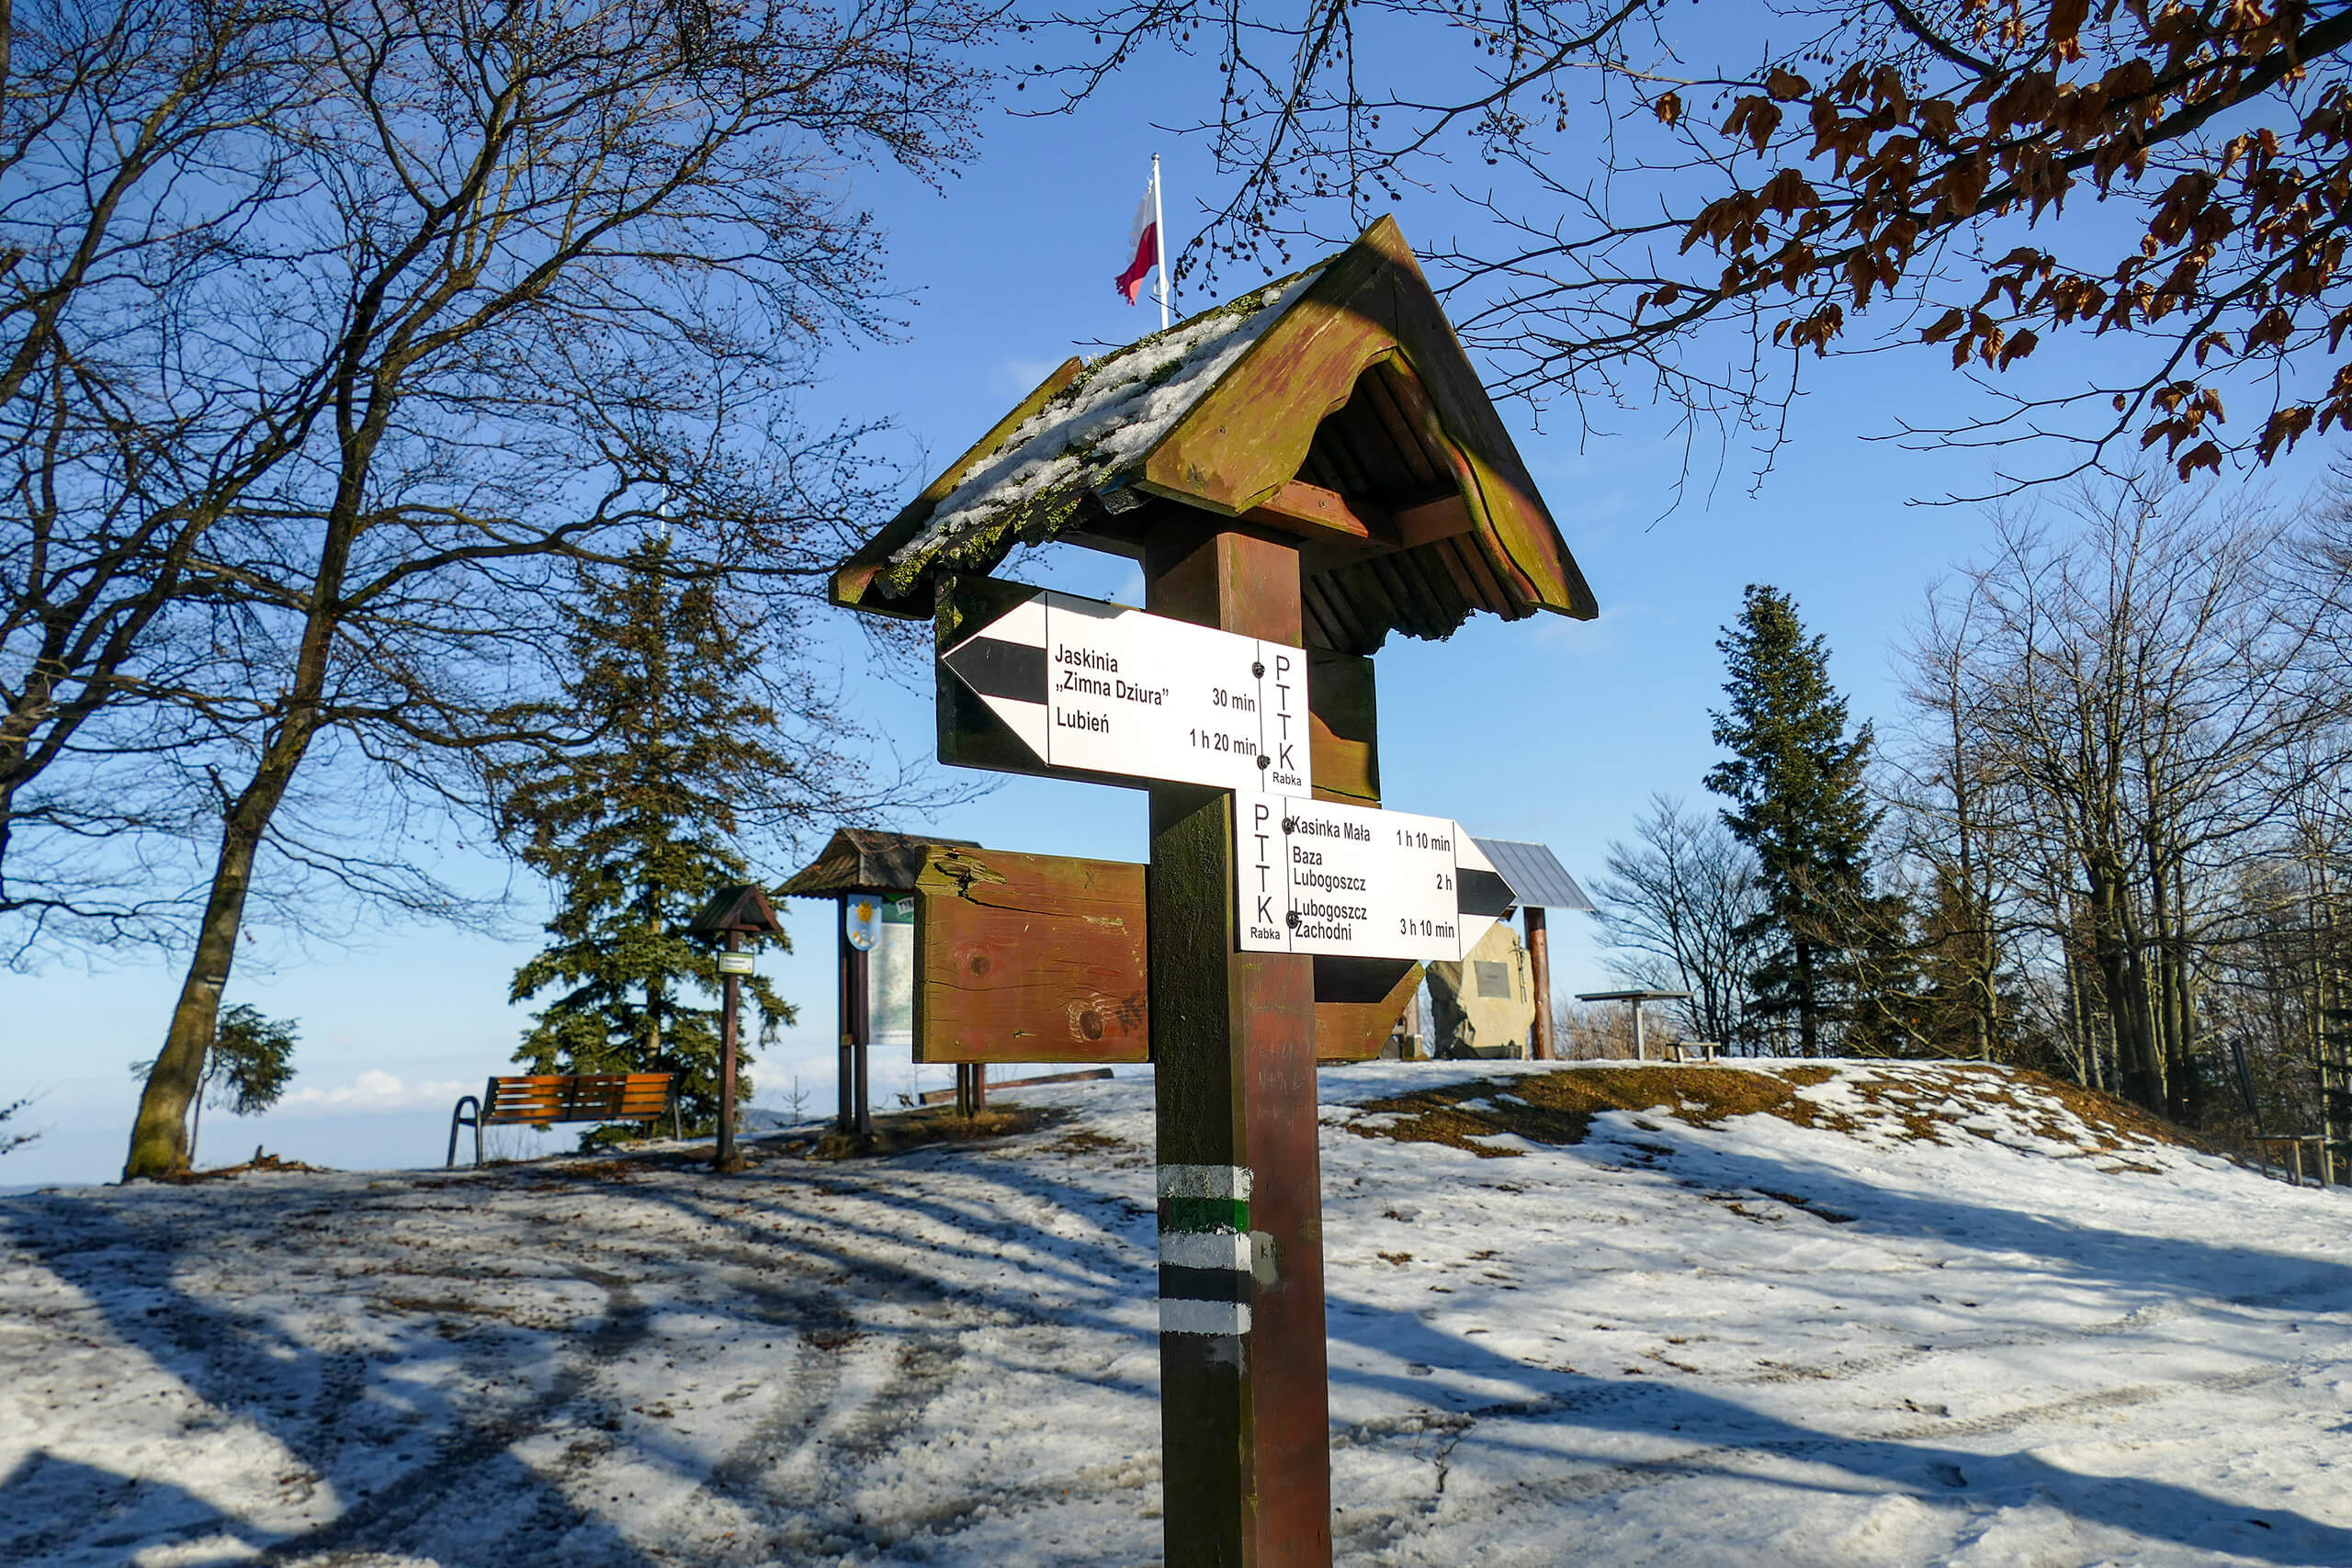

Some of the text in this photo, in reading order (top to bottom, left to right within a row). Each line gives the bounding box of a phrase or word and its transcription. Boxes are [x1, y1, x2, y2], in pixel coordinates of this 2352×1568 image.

[1055, 643, 1118, 673] Jaskinia
[1213, 687, 1256, 713] 30 min
[1057, 705, 1109, 734] Lubień
[1190, 728, 1257, 756] 1 h 20 min
[1272, 772, 1302, 786] Rabka
[1292, 815, 1371, 842] Kasinka Mała
[1396, 829, 1451, 852] 1 h 10 min
[1293, 845, 1323, 865] Baza
[1294, 867, 1366, 893] Lubogoszcz
[1436, 873, 1453, 891] 2 h
[1295, 897, 1367, 922] Lubogoszcz
[1250, 927, 1281, 940] Rabka
[1295, 920, 1352, 941] Zachodni
[1400, 918, 1455, 939] 3 h 10 min
